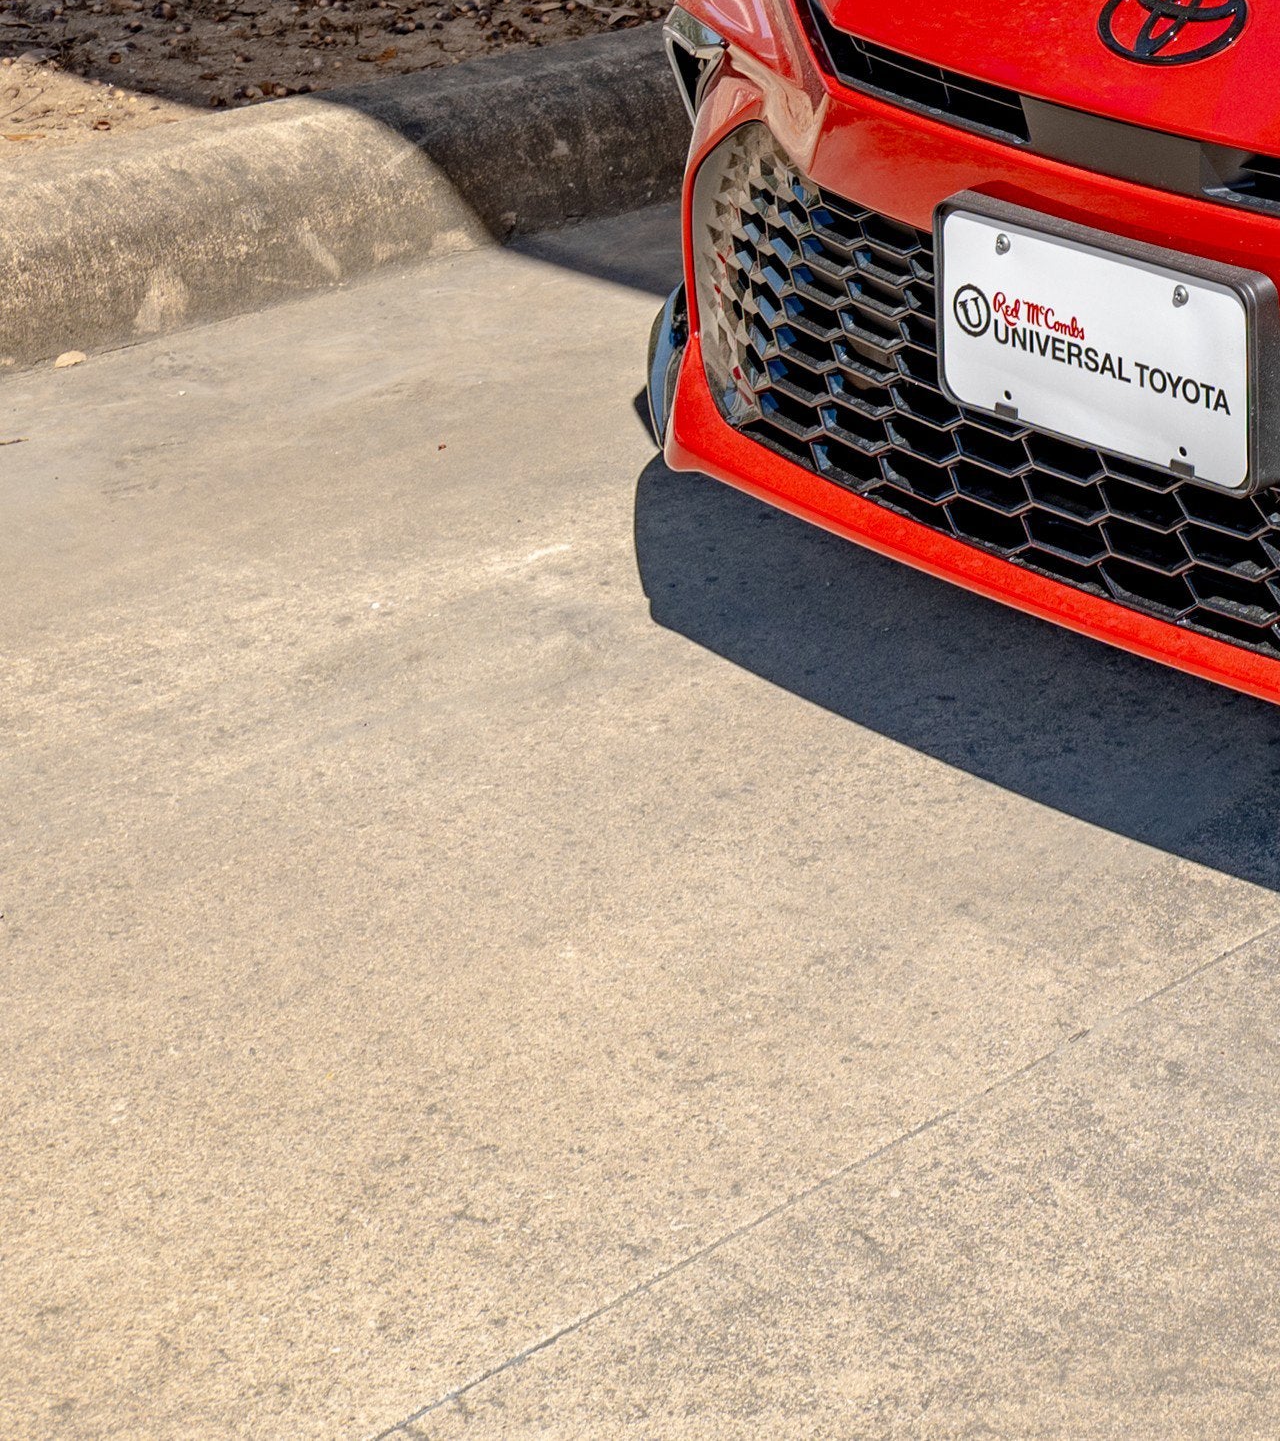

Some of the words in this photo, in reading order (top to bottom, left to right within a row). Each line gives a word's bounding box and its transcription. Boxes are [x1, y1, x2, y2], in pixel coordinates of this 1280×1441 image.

[993, 291, 1020, 327] Red
[1022, 300, 1085, 340] McCombs
[994, 318, 1131, 384] UNIVERSAL
[1134, 361, 1231, 416] TOYOTA
